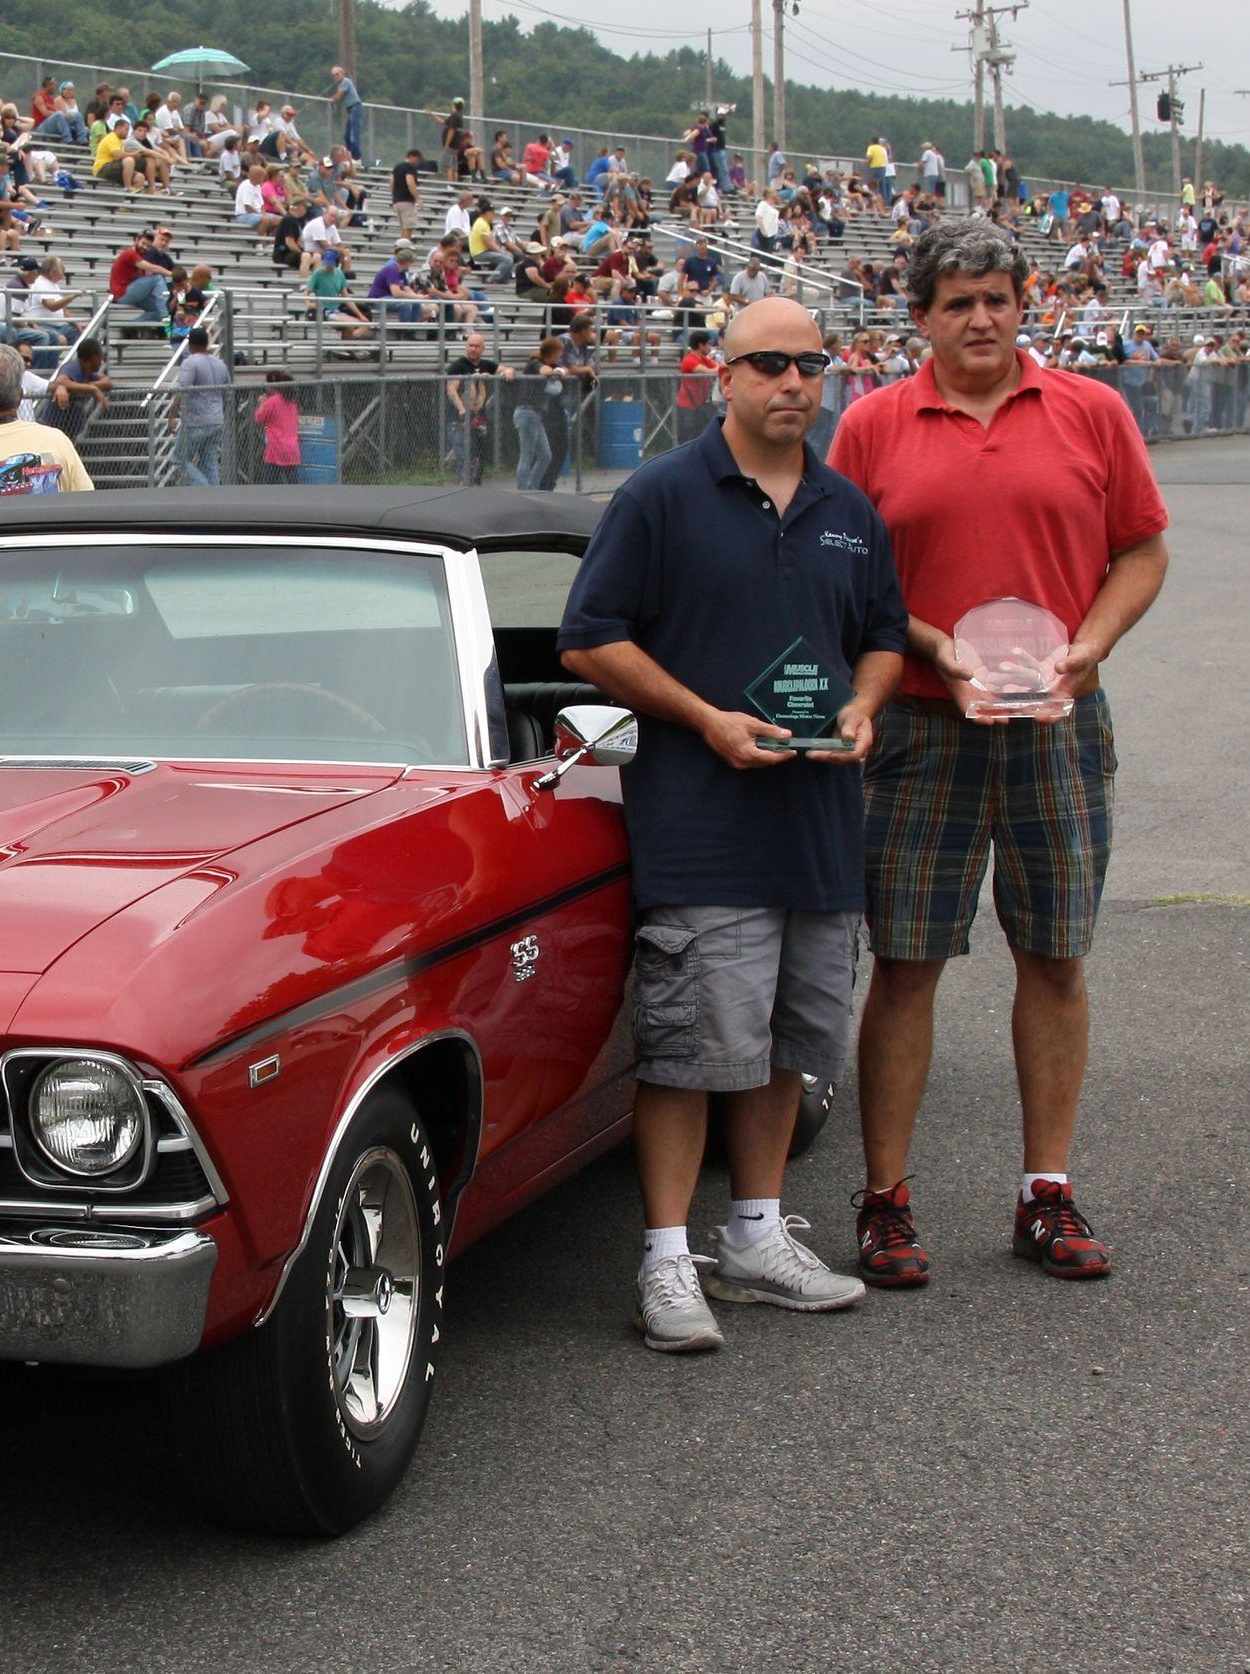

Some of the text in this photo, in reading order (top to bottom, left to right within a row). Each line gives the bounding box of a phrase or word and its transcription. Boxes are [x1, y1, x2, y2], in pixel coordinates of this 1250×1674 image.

[819, 676, 829, 691] XX
[510, 934, 540, 967] SS
[410, 1122, 444, 1382] UNIROYAL
[335, 1406, 361, 1468] TIGER
